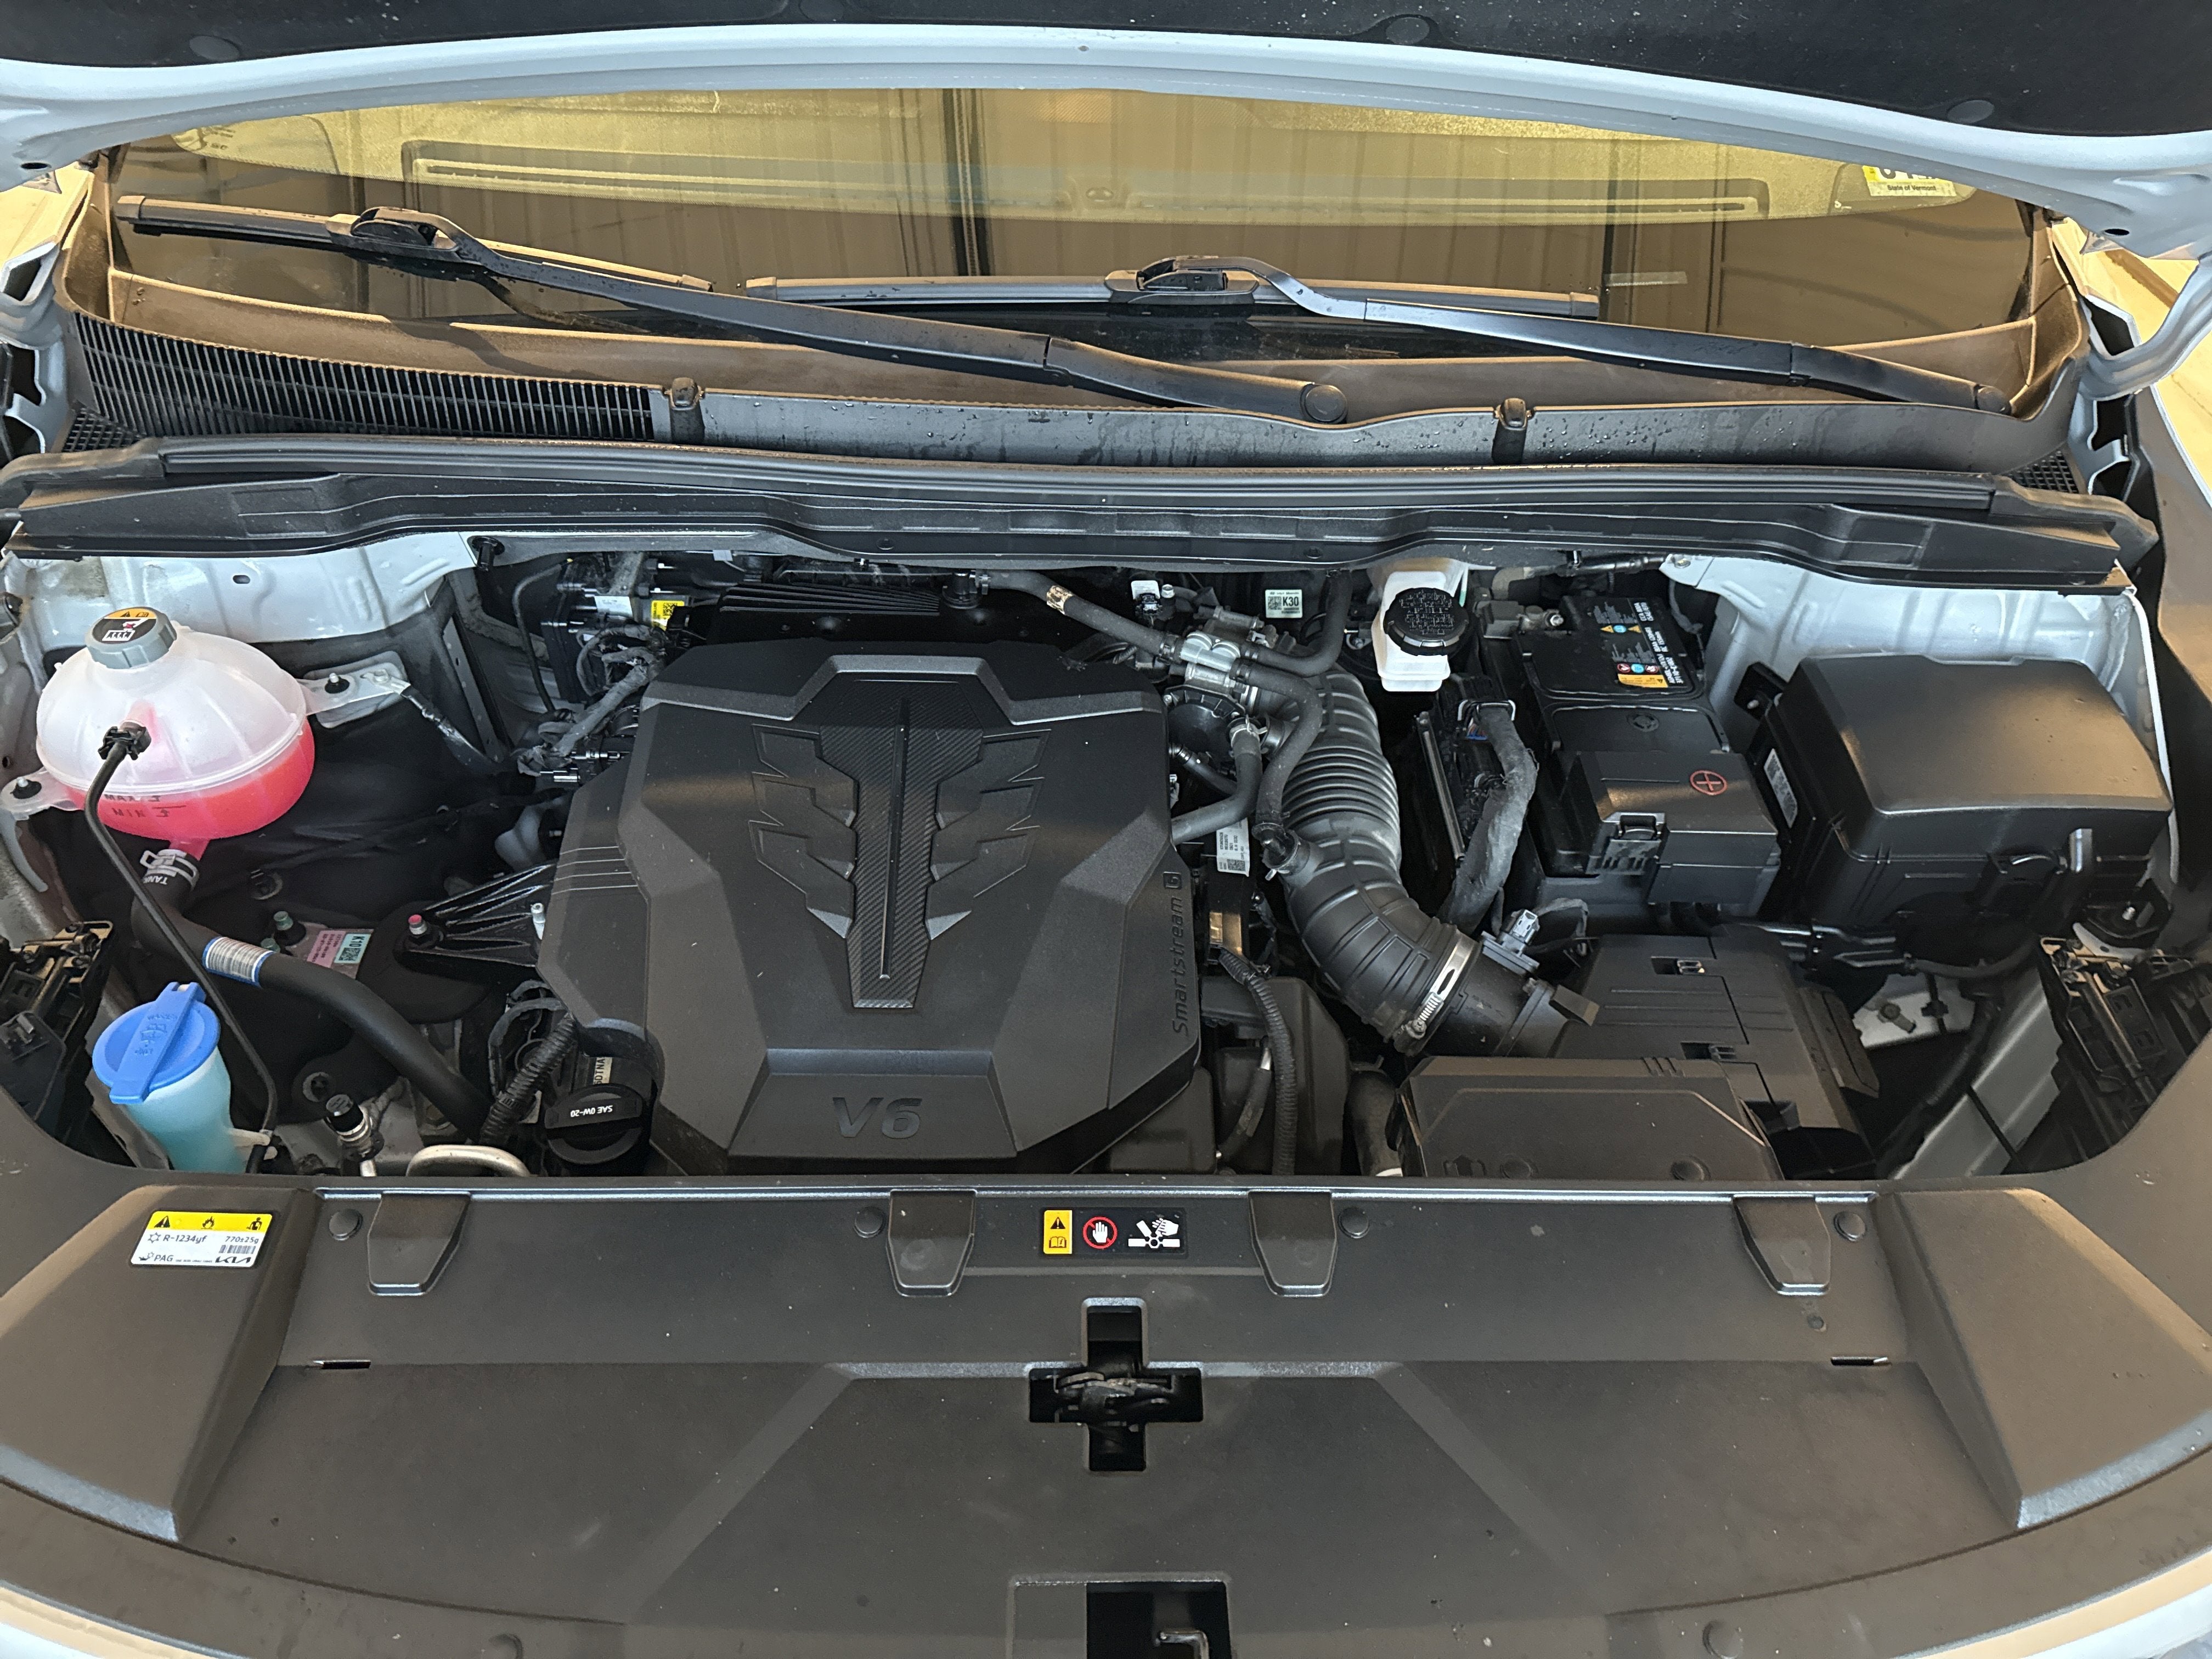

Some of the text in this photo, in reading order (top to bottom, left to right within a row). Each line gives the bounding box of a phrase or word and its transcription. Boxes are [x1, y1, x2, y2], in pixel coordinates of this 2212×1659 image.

[1283, 596, 1299, 607] K30
[112, 808, 146, 817] MIN
[349, 936, 365, 947] K10
[1170, 896, 1189, 1037] Smartstream
[570, 1105, 613, 1118] SAE 0W-20
[832, 1097, 922, 1139] V6
[163, 1234, 259, 1244] R-1234yf 770±25g
